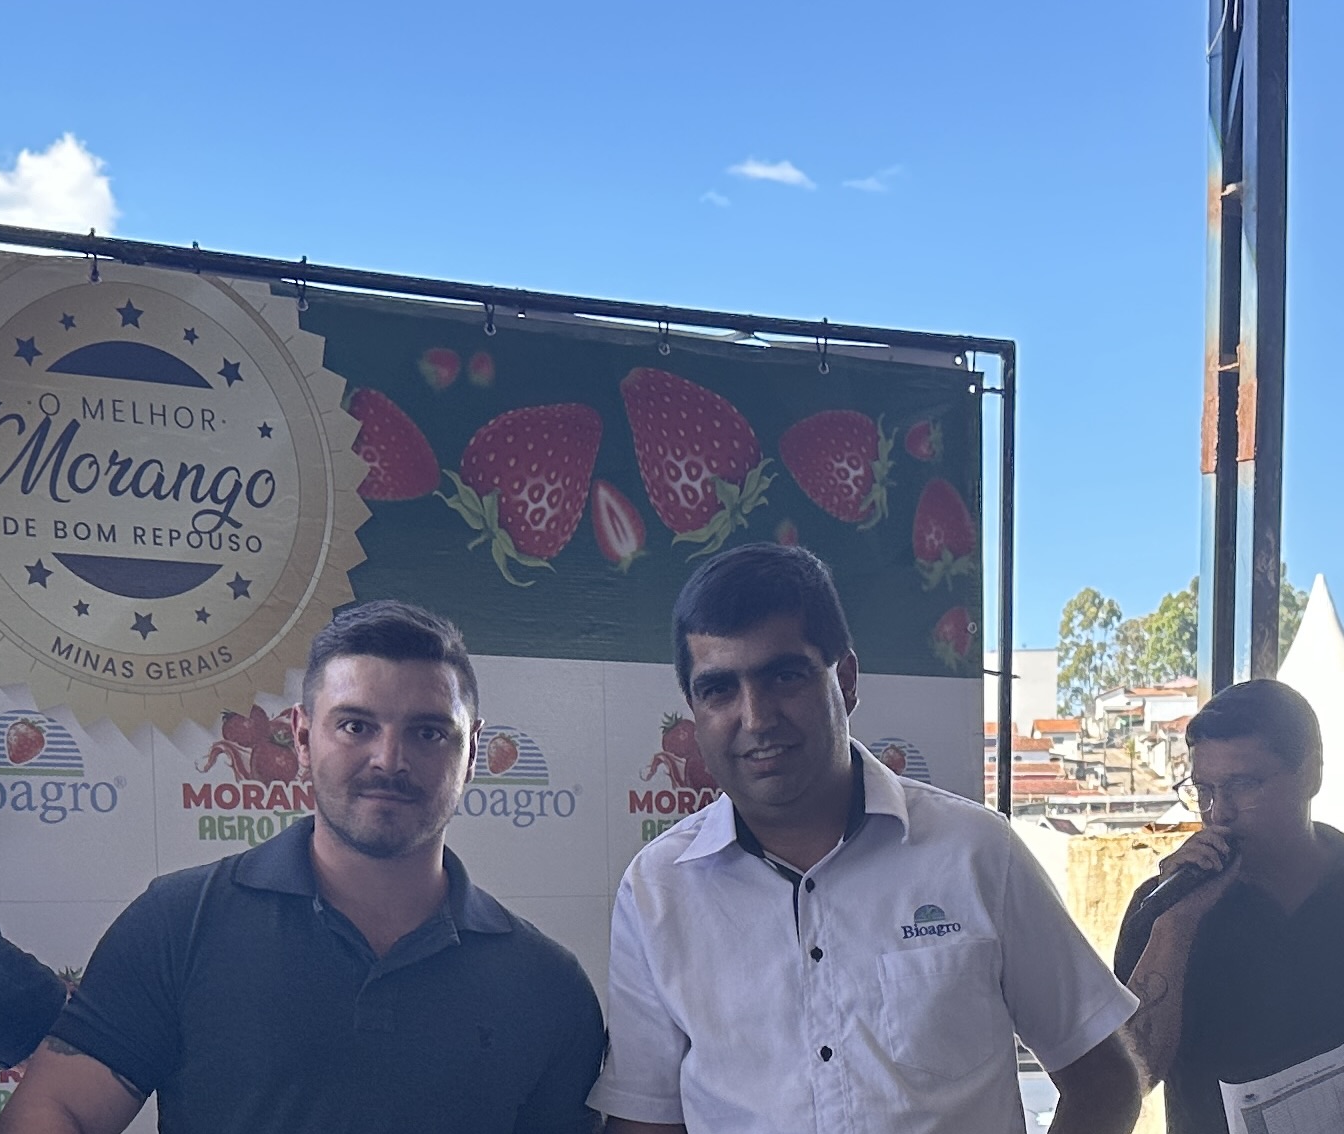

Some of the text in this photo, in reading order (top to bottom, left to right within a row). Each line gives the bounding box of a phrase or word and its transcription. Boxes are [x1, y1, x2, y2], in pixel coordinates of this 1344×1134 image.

[38, 392, 216, 431] O MELHOR
[2, 516, 263, 554] DE BOM REPOUSO
[51, 636, 234, 681] MINAS GERAIS
[182, 782, 315, 811] MORAN
[455, 783, 583, 828] oagro®
[629, 790, 718, 814] MORA
[198, 810, 314, 848] AGROT
[901, 922, 961, 939] Bioagro
